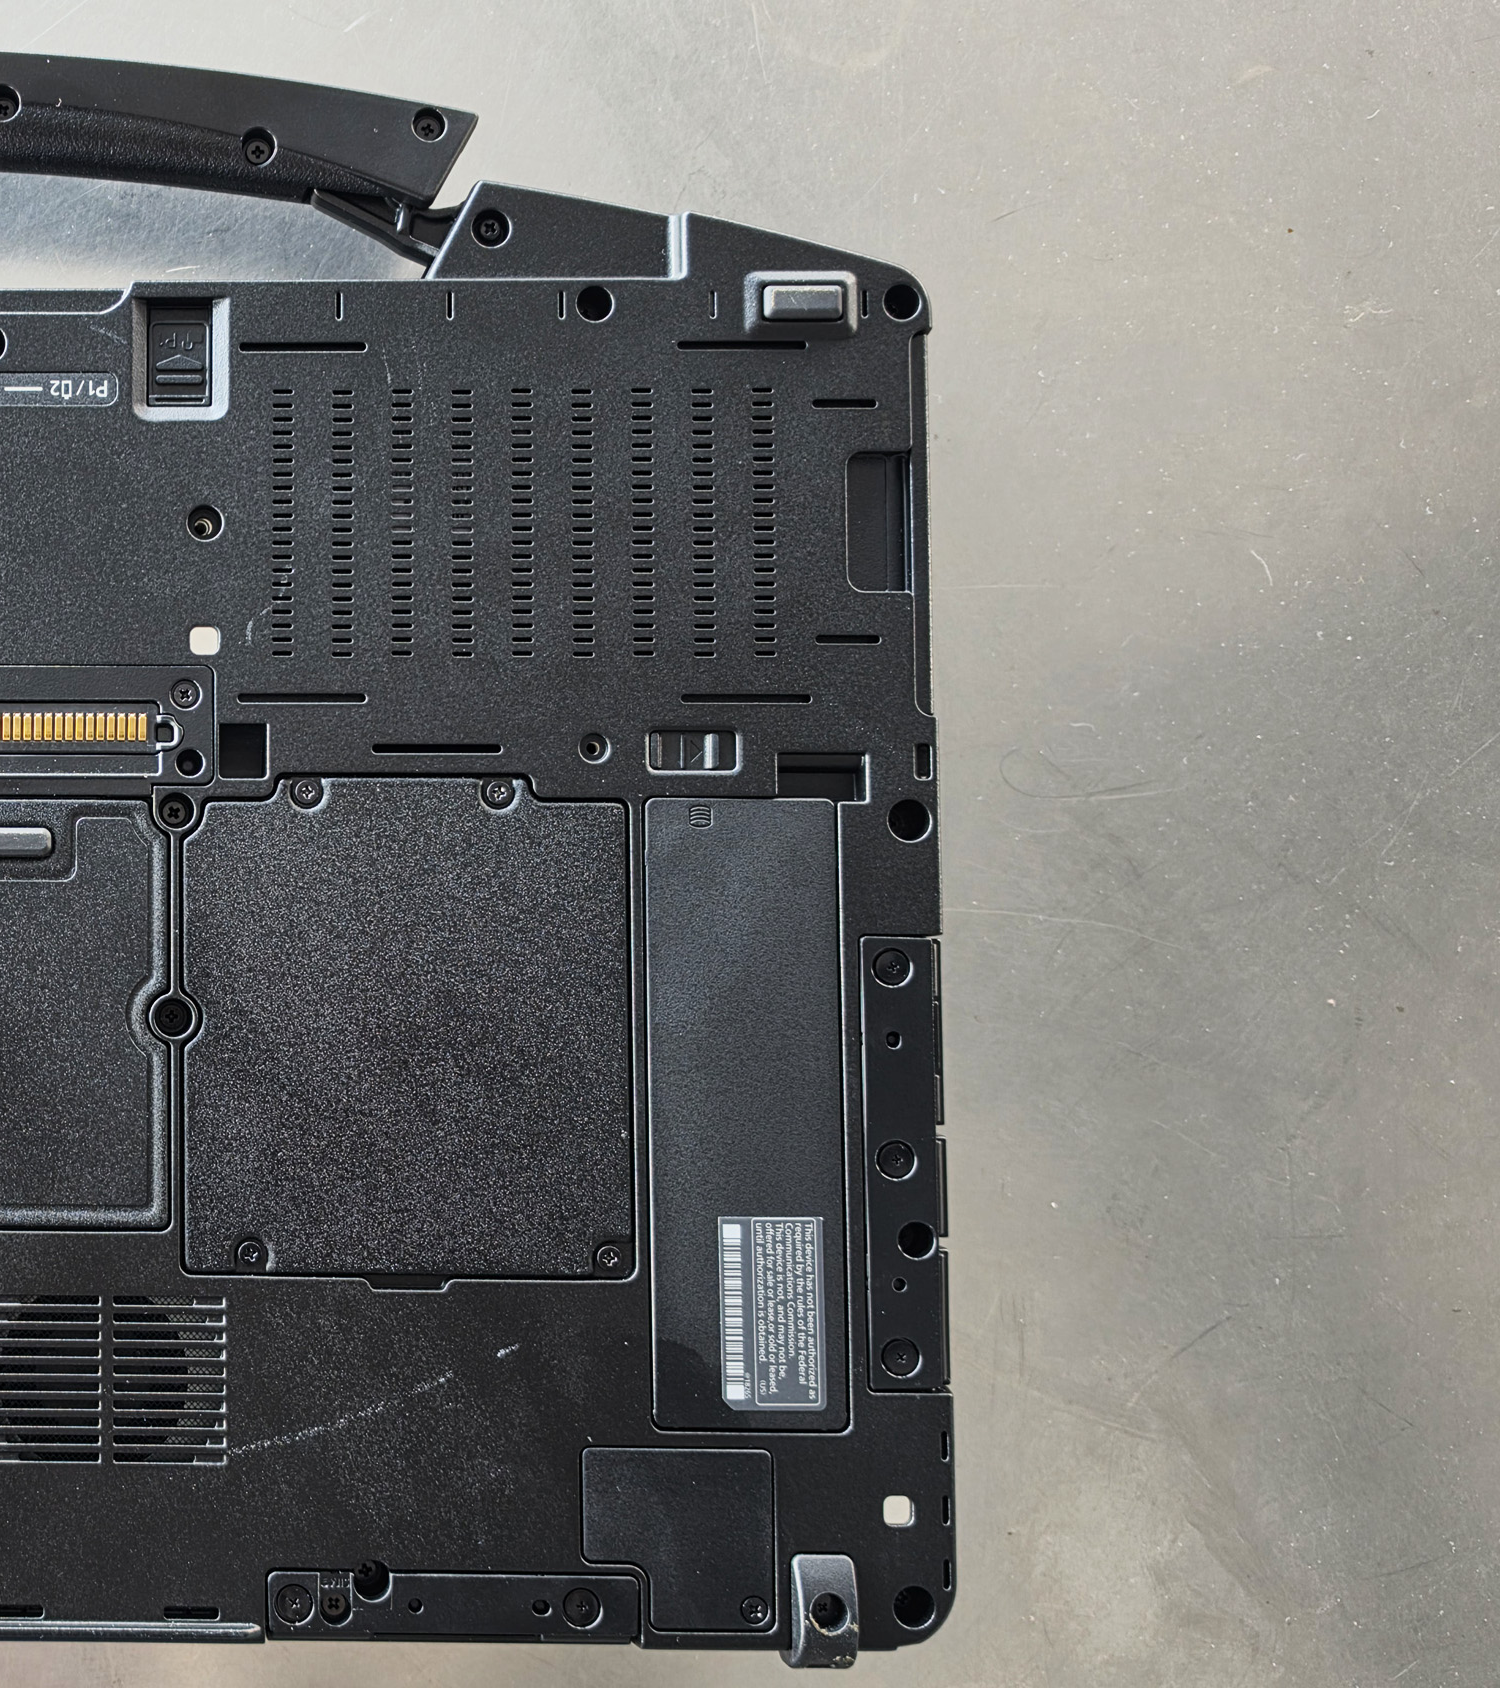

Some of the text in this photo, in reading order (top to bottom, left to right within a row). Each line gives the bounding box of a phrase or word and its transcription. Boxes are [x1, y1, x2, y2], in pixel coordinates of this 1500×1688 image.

[786, 1223, 796, 1359] Communications Commission.
[804, 1223, 816, 1400] This device has not been authorized as
